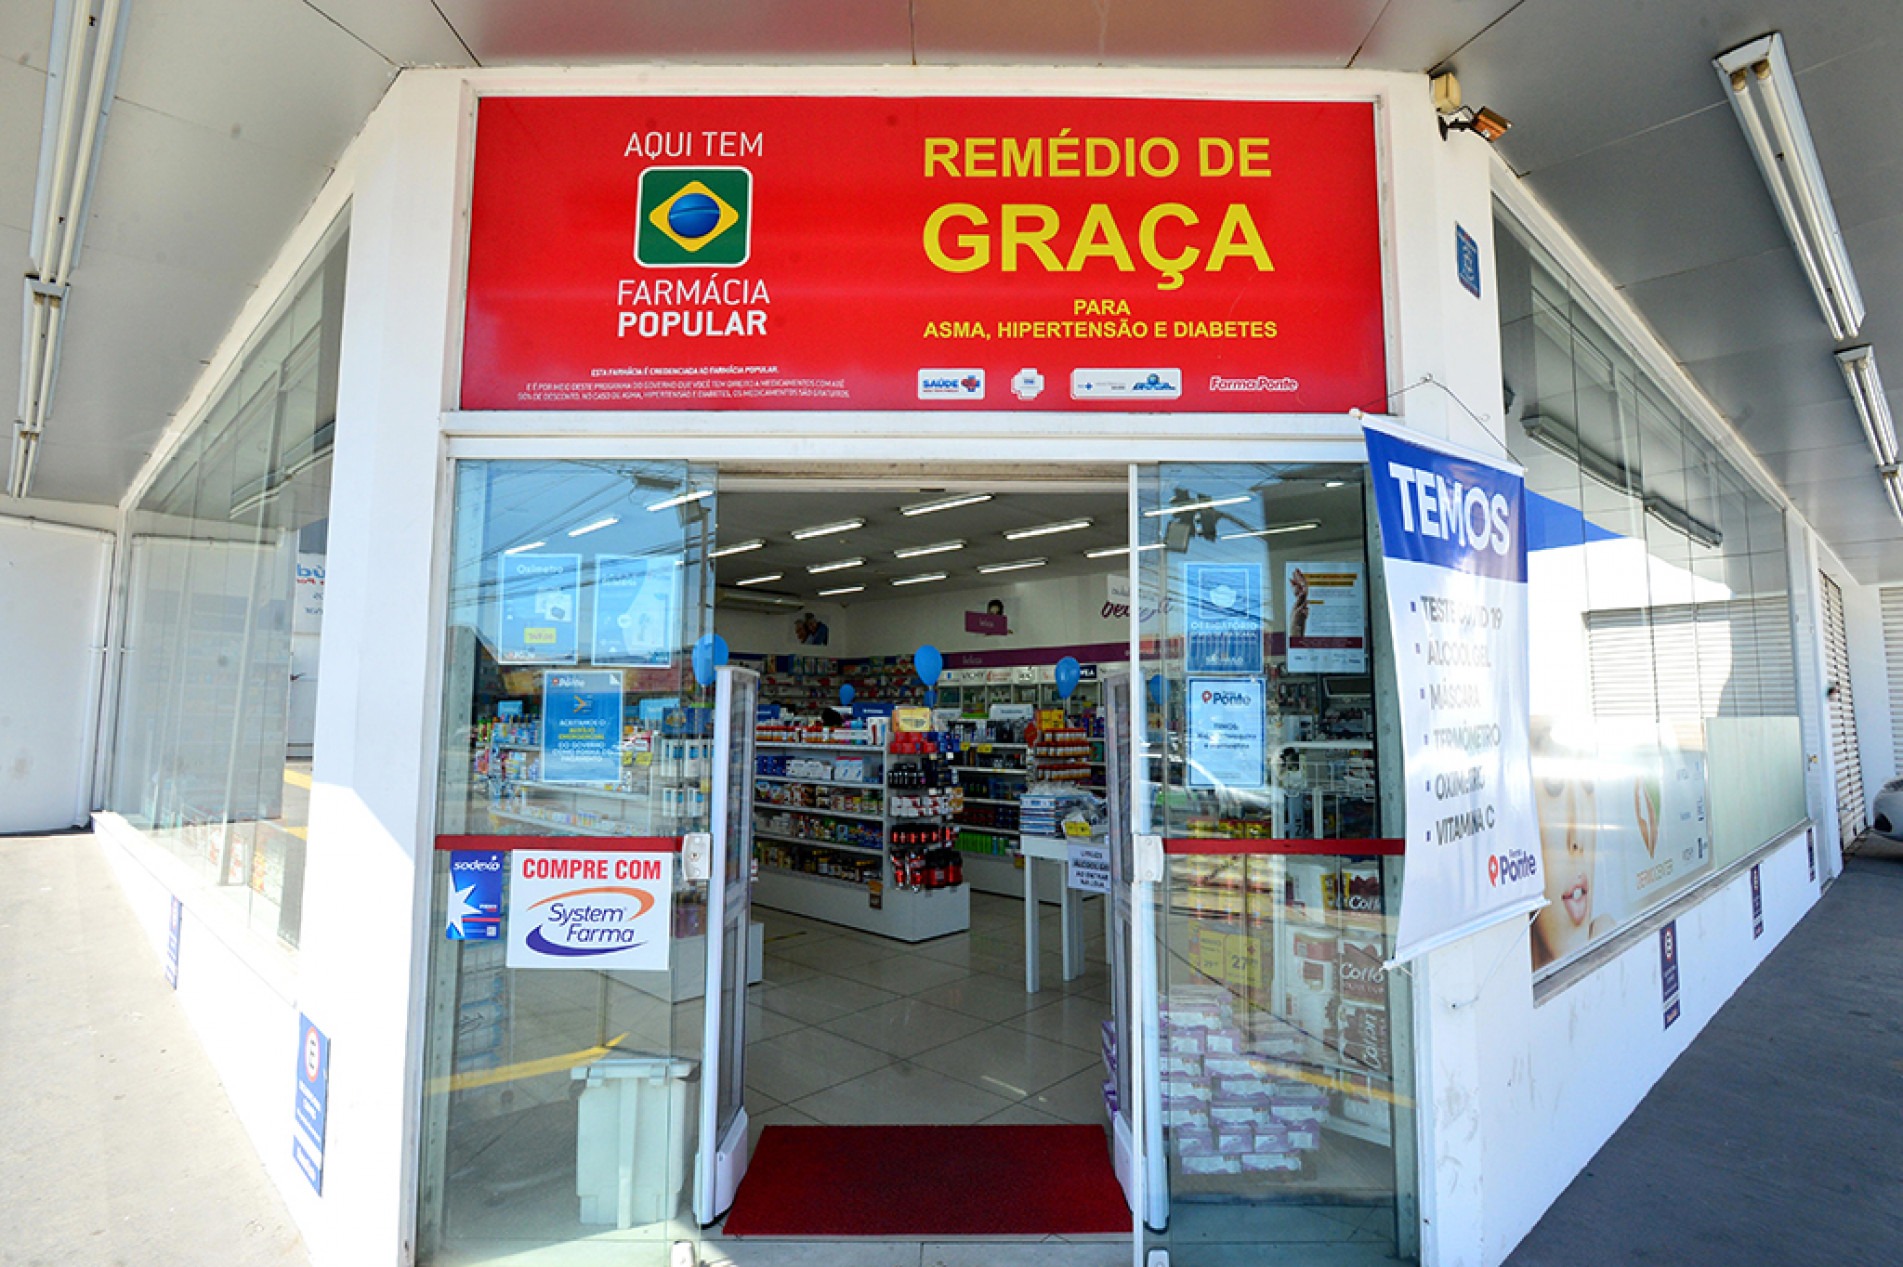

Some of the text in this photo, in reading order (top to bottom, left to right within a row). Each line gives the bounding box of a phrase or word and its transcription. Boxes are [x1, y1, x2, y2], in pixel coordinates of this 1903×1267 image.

[624, 131, 763, 160] AQUI TEM
[923, 127, 1272, 178] REMÉDIO DE
[922, 203, 1276, 291] GRAÇA
[616, 273, 770, 306] FARMÁCIA
[1073, 299, 1131, 316] PARA
[617, 310, 768, 338] POPULAR
[923, 319, 1278, 341] ASMA, HIPERTENSÃO E DIABETES
[1388, 461, 1510, 556] TEMOS
[1420, 595, 1455, 624] TESTE
[1435, 804, 1495, 846] VITAMINA C
[522, 858, 662, 881] COMPRE COM
[1500, 853, 1536, 885] Ponte
[548, 903, 624, 927] System
[566, 923, 635, 943] Farma
